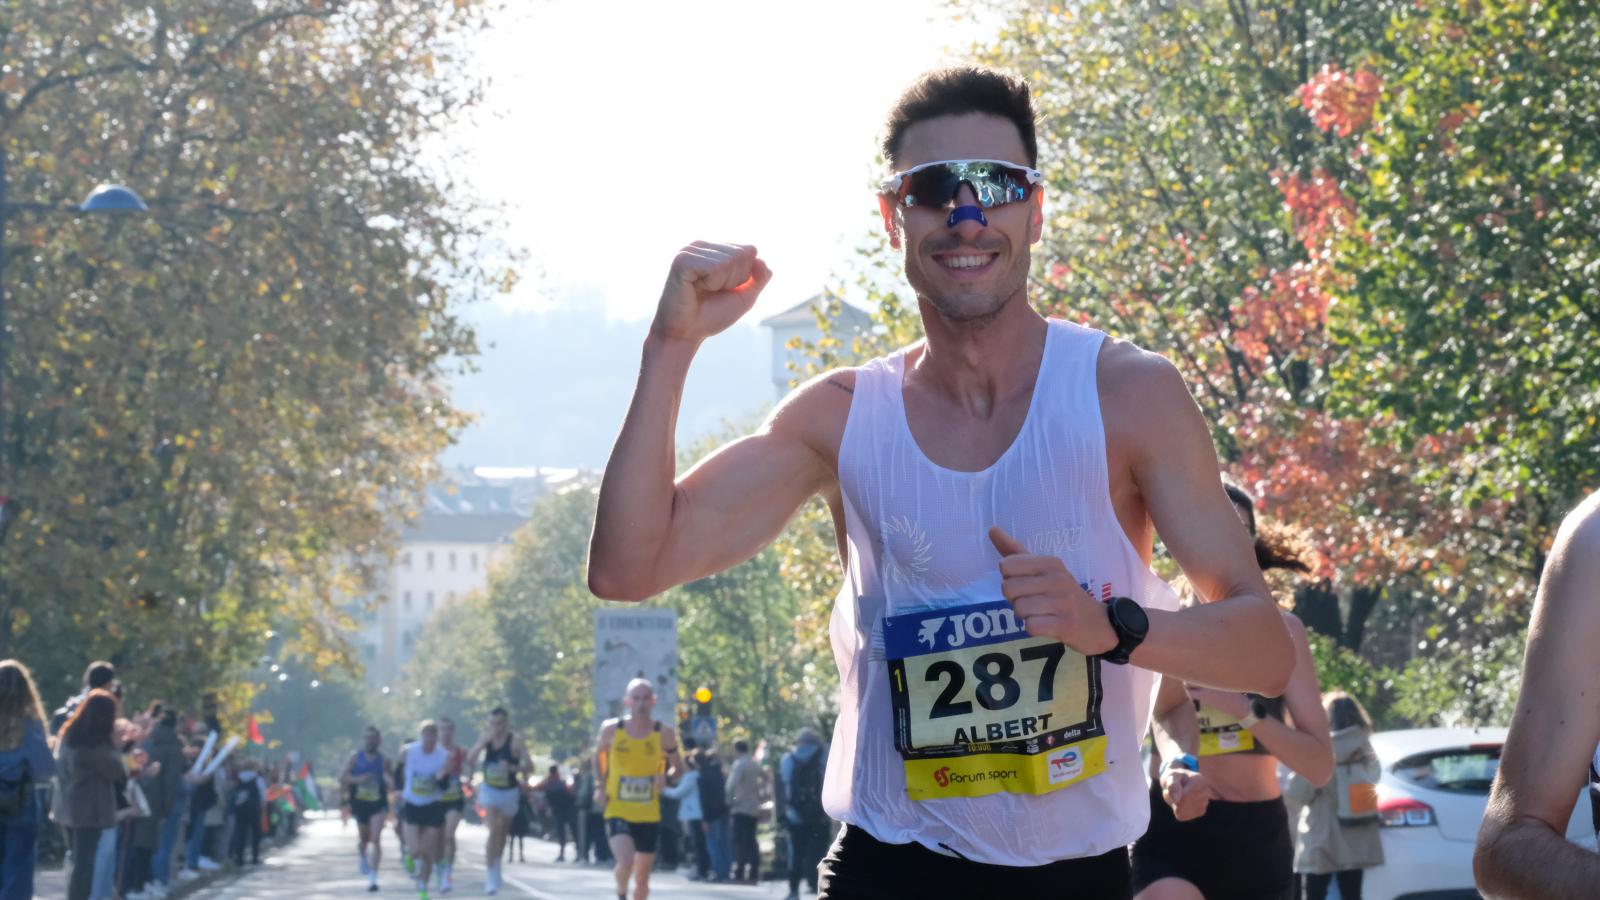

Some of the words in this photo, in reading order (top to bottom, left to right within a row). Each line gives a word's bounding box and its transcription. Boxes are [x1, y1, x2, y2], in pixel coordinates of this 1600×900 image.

[894, 669, 903, 693] 1
[925, 642, 1066, 720] 287
[953, 713, 1053, 745] ALBERT
[1063, 729, 1081, 739] delta
[988, 769, 1018, 781] sport
